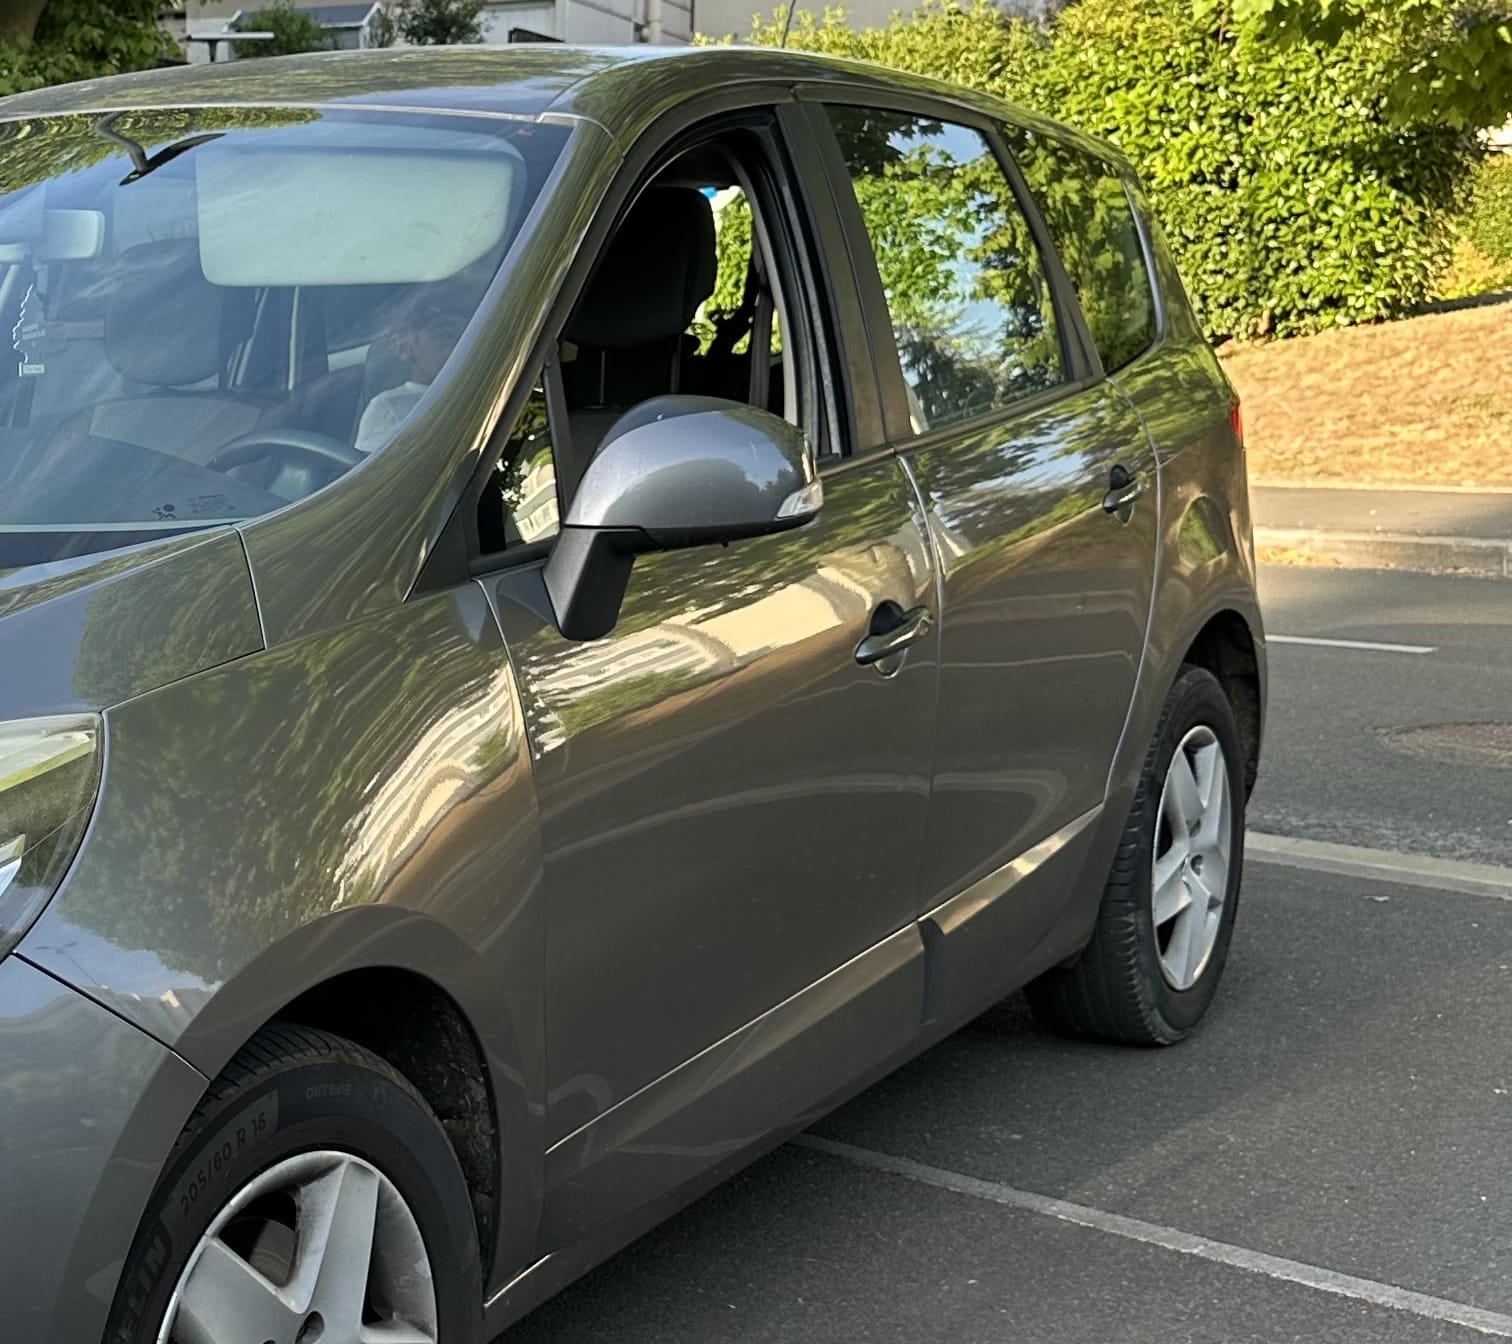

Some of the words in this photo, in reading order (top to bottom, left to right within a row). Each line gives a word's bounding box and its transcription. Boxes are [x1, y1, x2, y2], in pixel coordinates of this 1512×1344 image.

[306, 1083, 353, 1100] OUTSIDE
[180, 1142, 232, 1214] 205/60
[236, 1127, 247, 1146] R
[251, 1112, 267, 1136] 16
